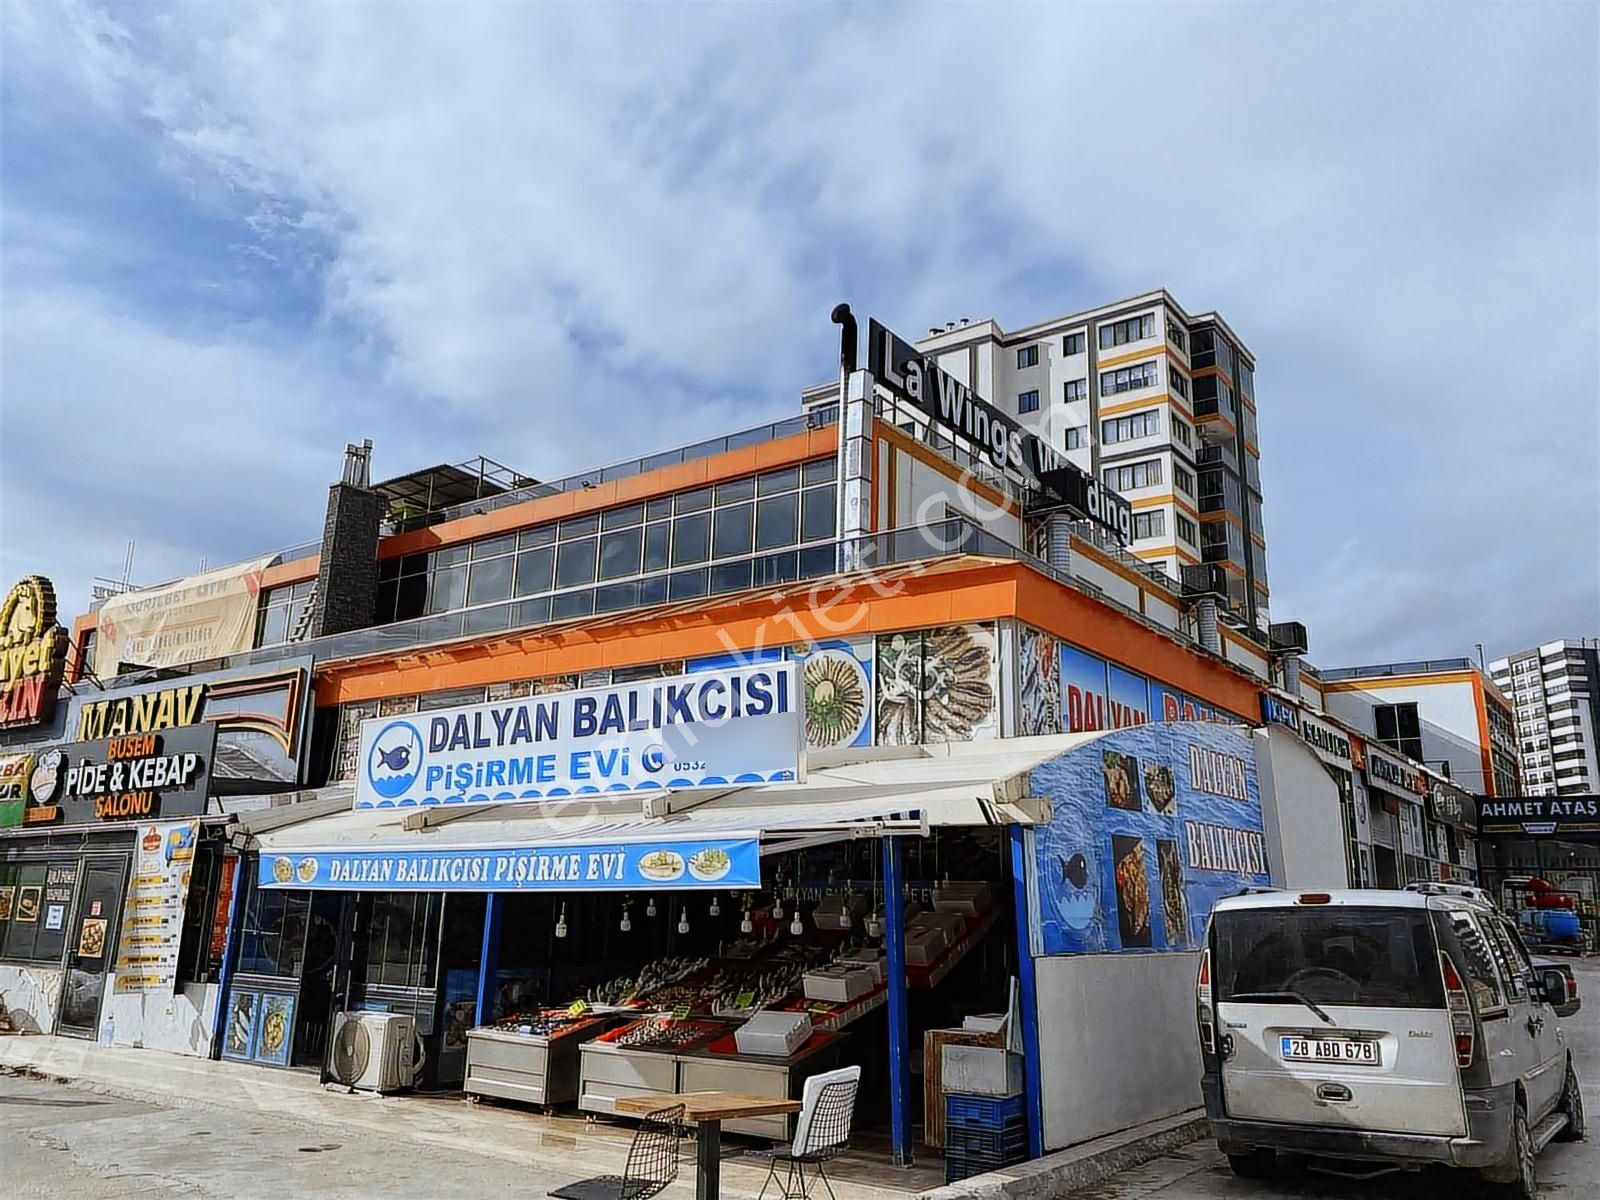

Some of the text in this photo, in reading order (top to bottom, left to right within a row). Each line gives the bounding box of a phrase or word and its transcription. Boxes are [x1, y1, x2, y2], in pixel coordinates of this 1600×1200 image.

[936, 367, 1024, 467] Wings
[77, 684, 203, 742] MANAV
[429, 701, 560, 753] DALYAN
[107, 734, 155, 759] BUSEM
[66, 754, 196, 795] PİDE & KEBAP
[1188, 744, 1248, 802] DALYAN
[95, 791, 153, 817] SALONU
[1482, 801, 1597, 816] AHMET ATAŞ
[330, 846, 627, 888] DALYAN BALIKCISI PİŞİRME EVİ
[1184, 821, 1267, 879] BALIKÇISI
[1292, 1041, 1372, 1059] 28 ABD 678
